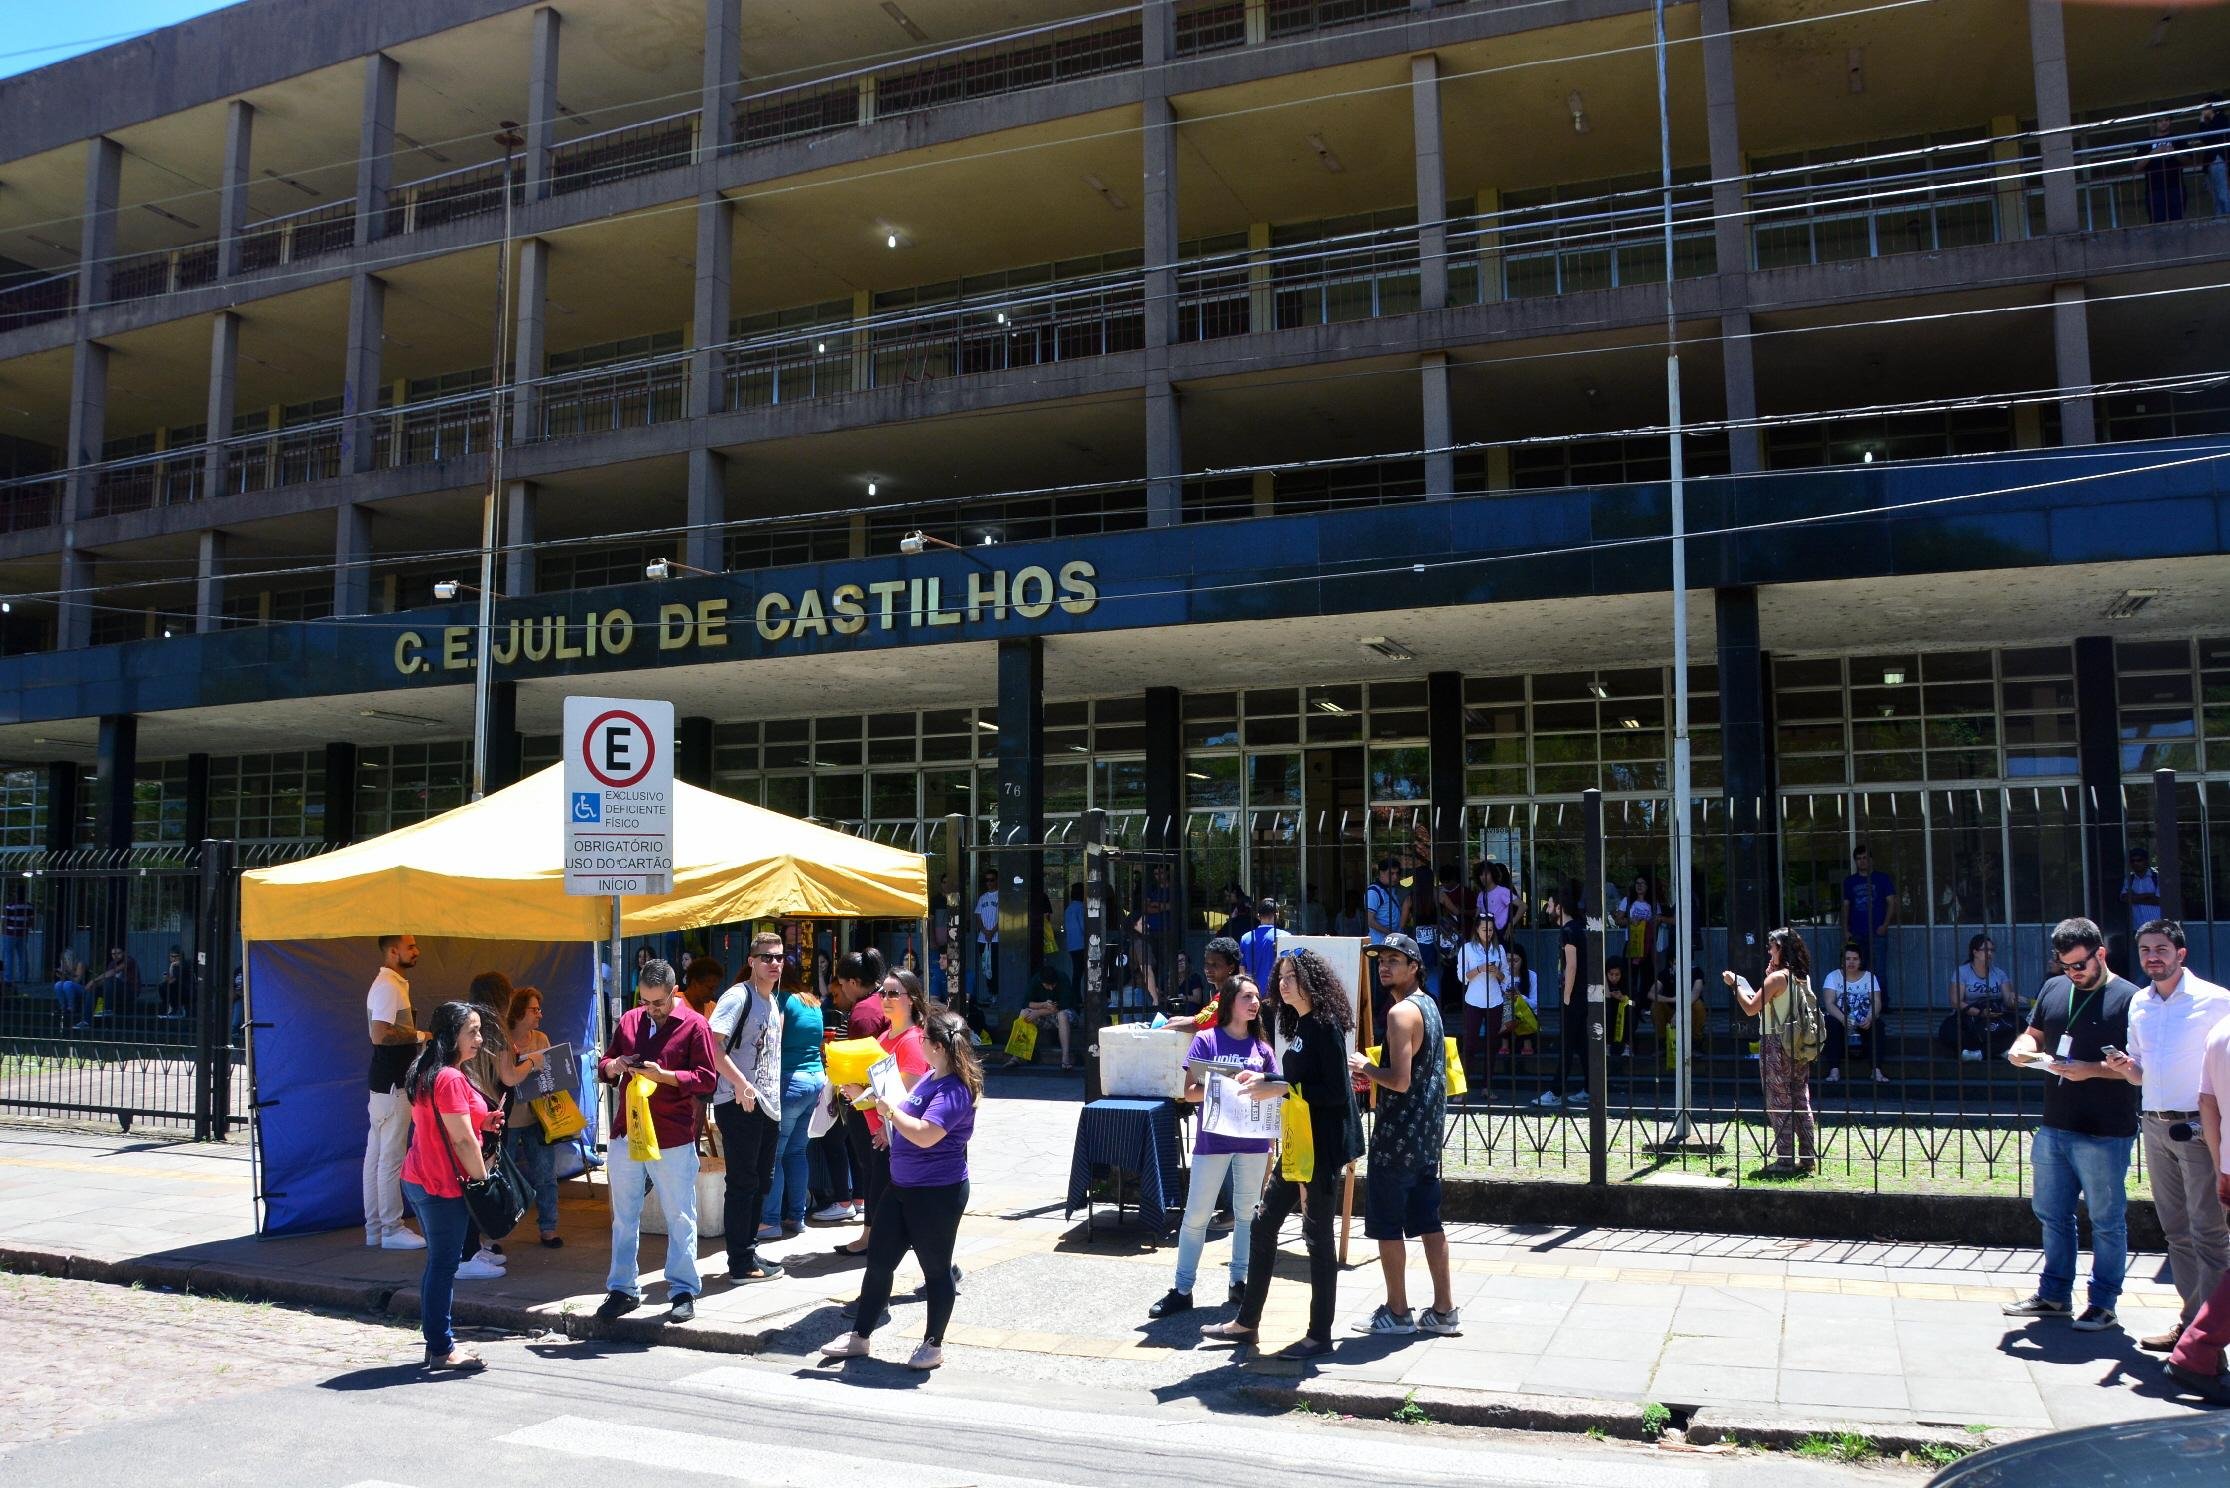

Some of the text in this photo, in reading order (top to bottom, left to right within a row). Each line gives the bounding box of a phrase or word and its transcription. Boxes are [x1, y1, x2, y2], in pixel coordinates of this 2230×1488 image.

[394, 631, 430, 675] C.
[492, 608, 633, 664] JULIO
[658, 598, 728, 650] DE
[755, 560, 1098, 641] CASTILHOS
[606, 727, 631, 770] E
[605, 790, 664, 801] EXCLUSIVO
[1004, 782, 1022, 798] 76
[605, 804, 666, 815] DEFICIENTE
[605, 816, 640, 829] FÍSICO
[574, 837, 663, 852] OBRIGATÓRIO
[565, 856, 672, 869] USO DO CARTÃO
[599, 879, 637, 891] INÍCIO
[1213, 1054, 1264, 1067] unificado
